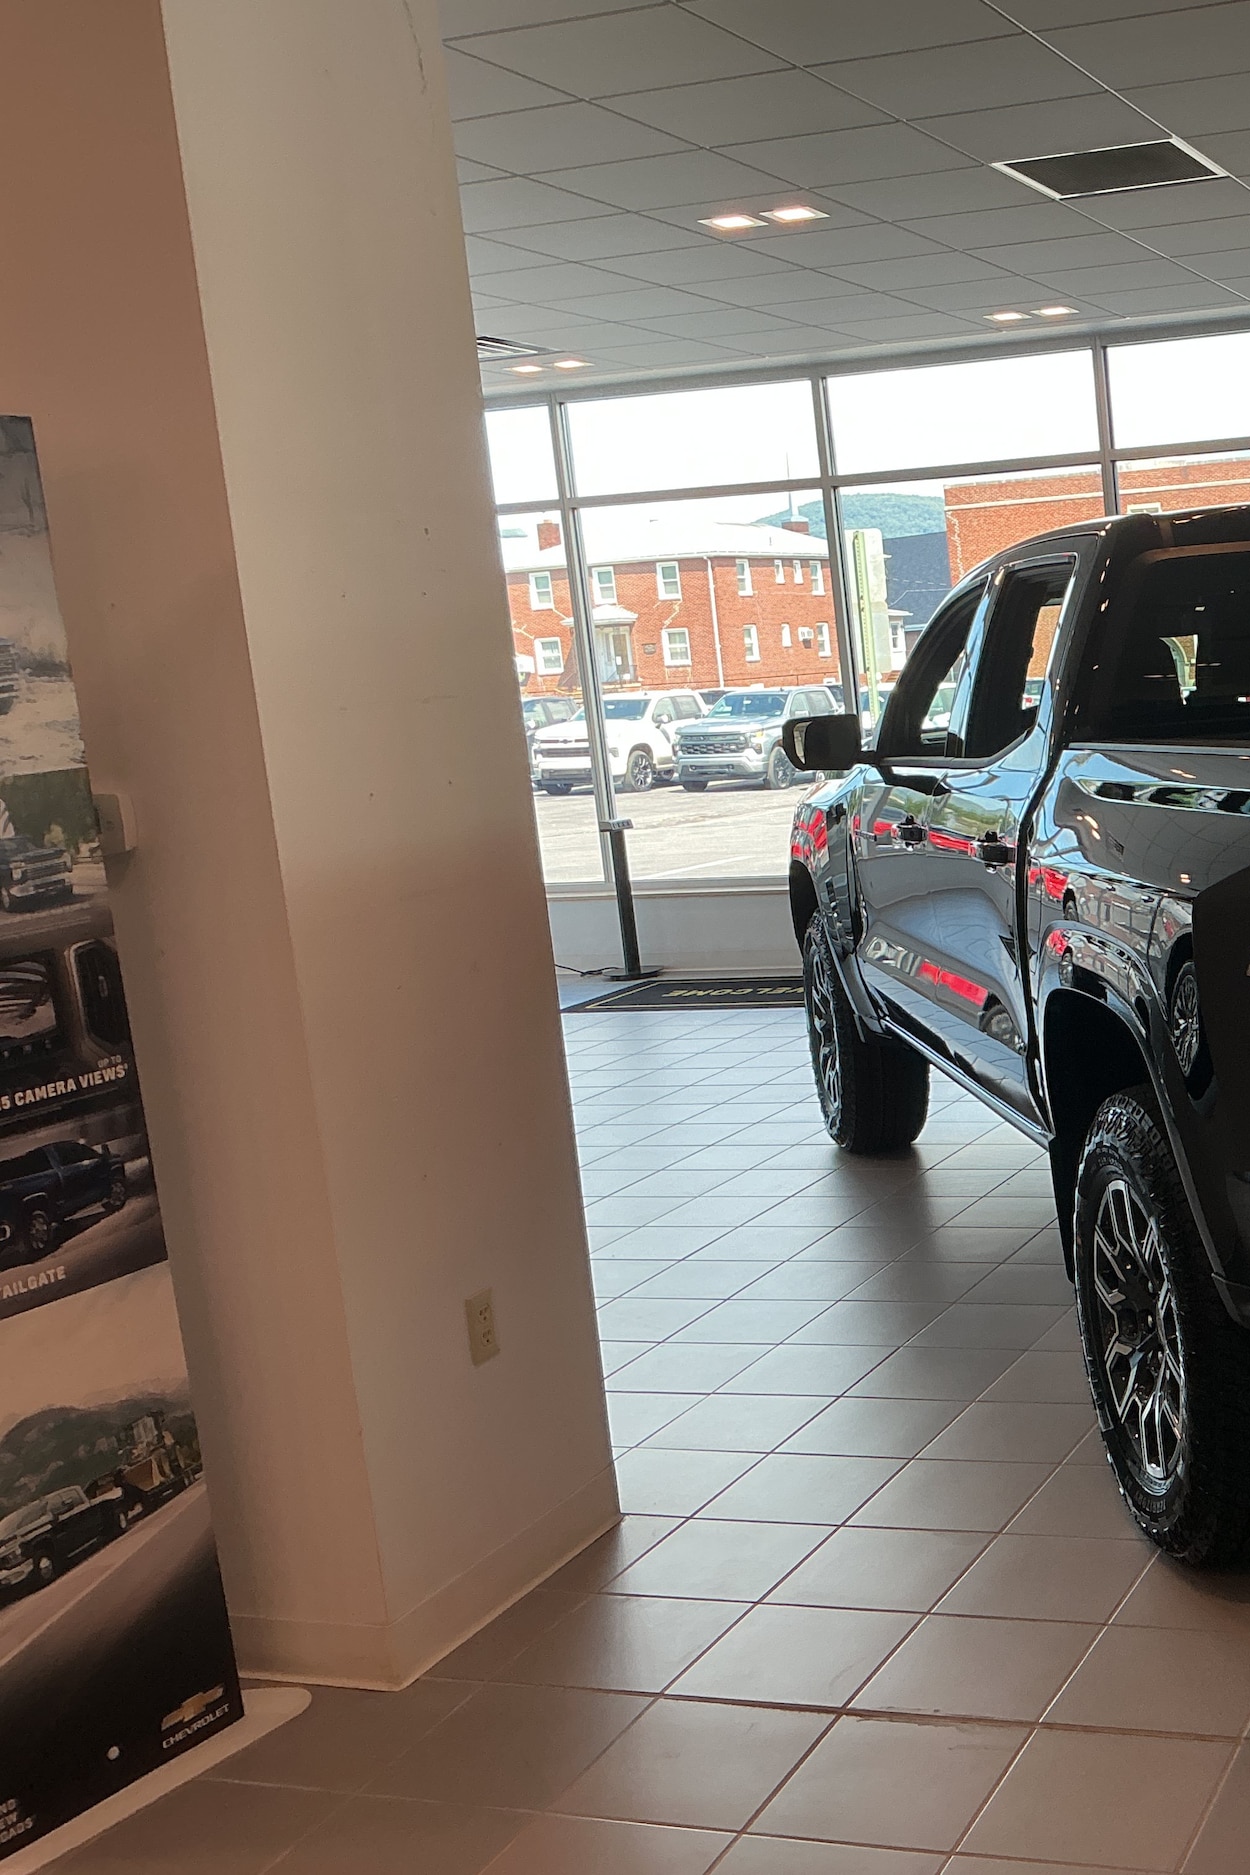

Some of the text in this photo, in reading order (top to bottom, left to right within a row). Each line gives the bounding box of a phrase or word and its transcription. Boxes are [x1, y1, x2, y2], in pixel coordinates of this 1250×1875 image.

[0, 1095, 11, 1112] 5
[14, 1078, 77, 1106] CAMERA
[0, 1266, 66, 1300] AILGATE
[162, 1702, 231, 1750] CHEVROLET
